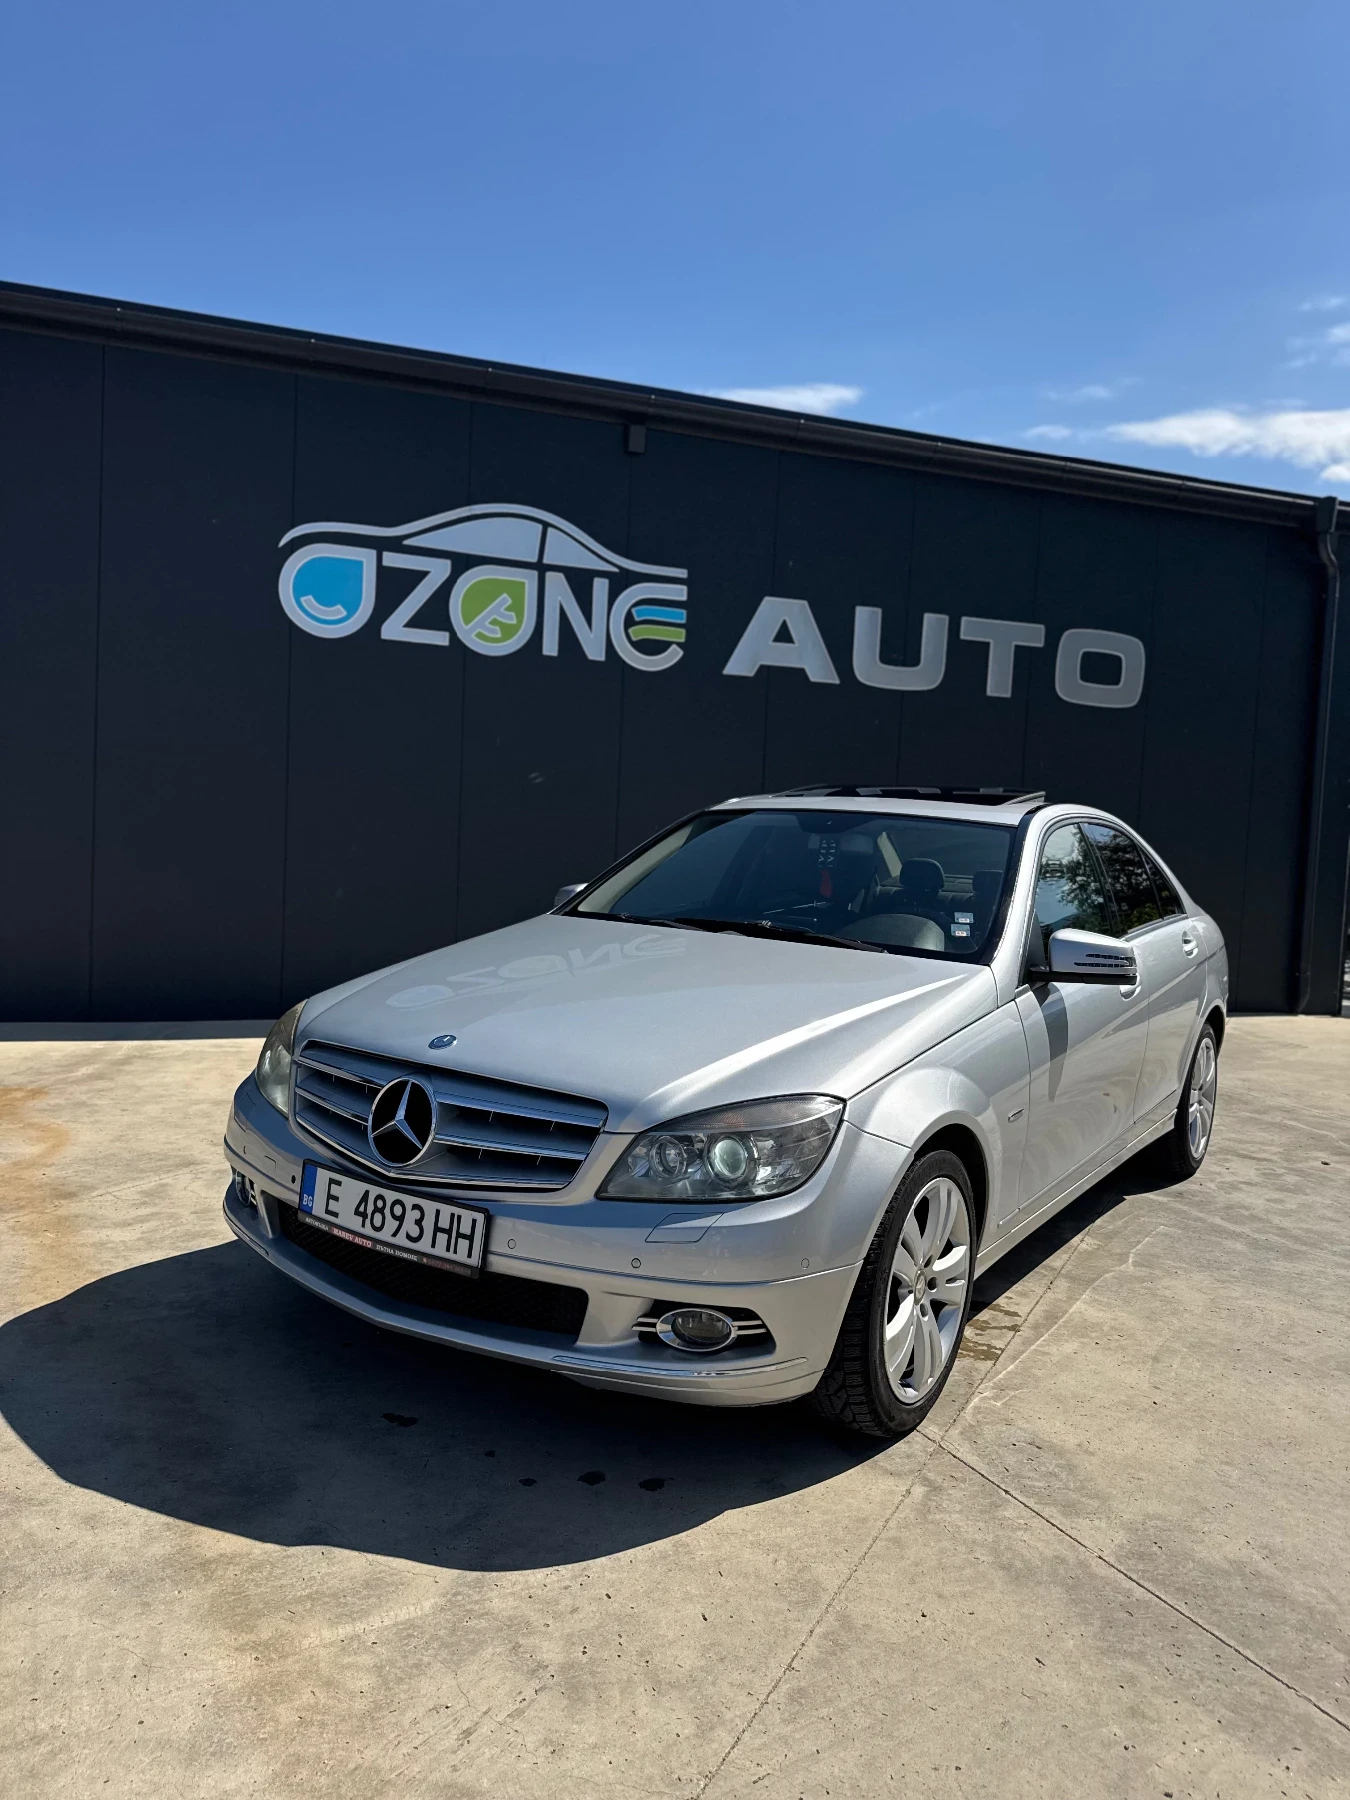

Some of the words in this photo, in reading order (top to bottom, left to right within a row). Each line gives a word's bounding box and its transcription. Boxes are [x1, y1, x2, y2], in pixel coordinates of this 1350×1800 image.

[278, 542, 688, 671] OZONE
[722, 596, 1146, 708] AUTO
[302, 1193, 313, 1207] BG
[324, 1177, 343, 1219] E
[353, 1189, 425, 1244] 4893
[333, 1227, 354, 1241] MANEV
[354, 1236, 372, 1247] AUTO
